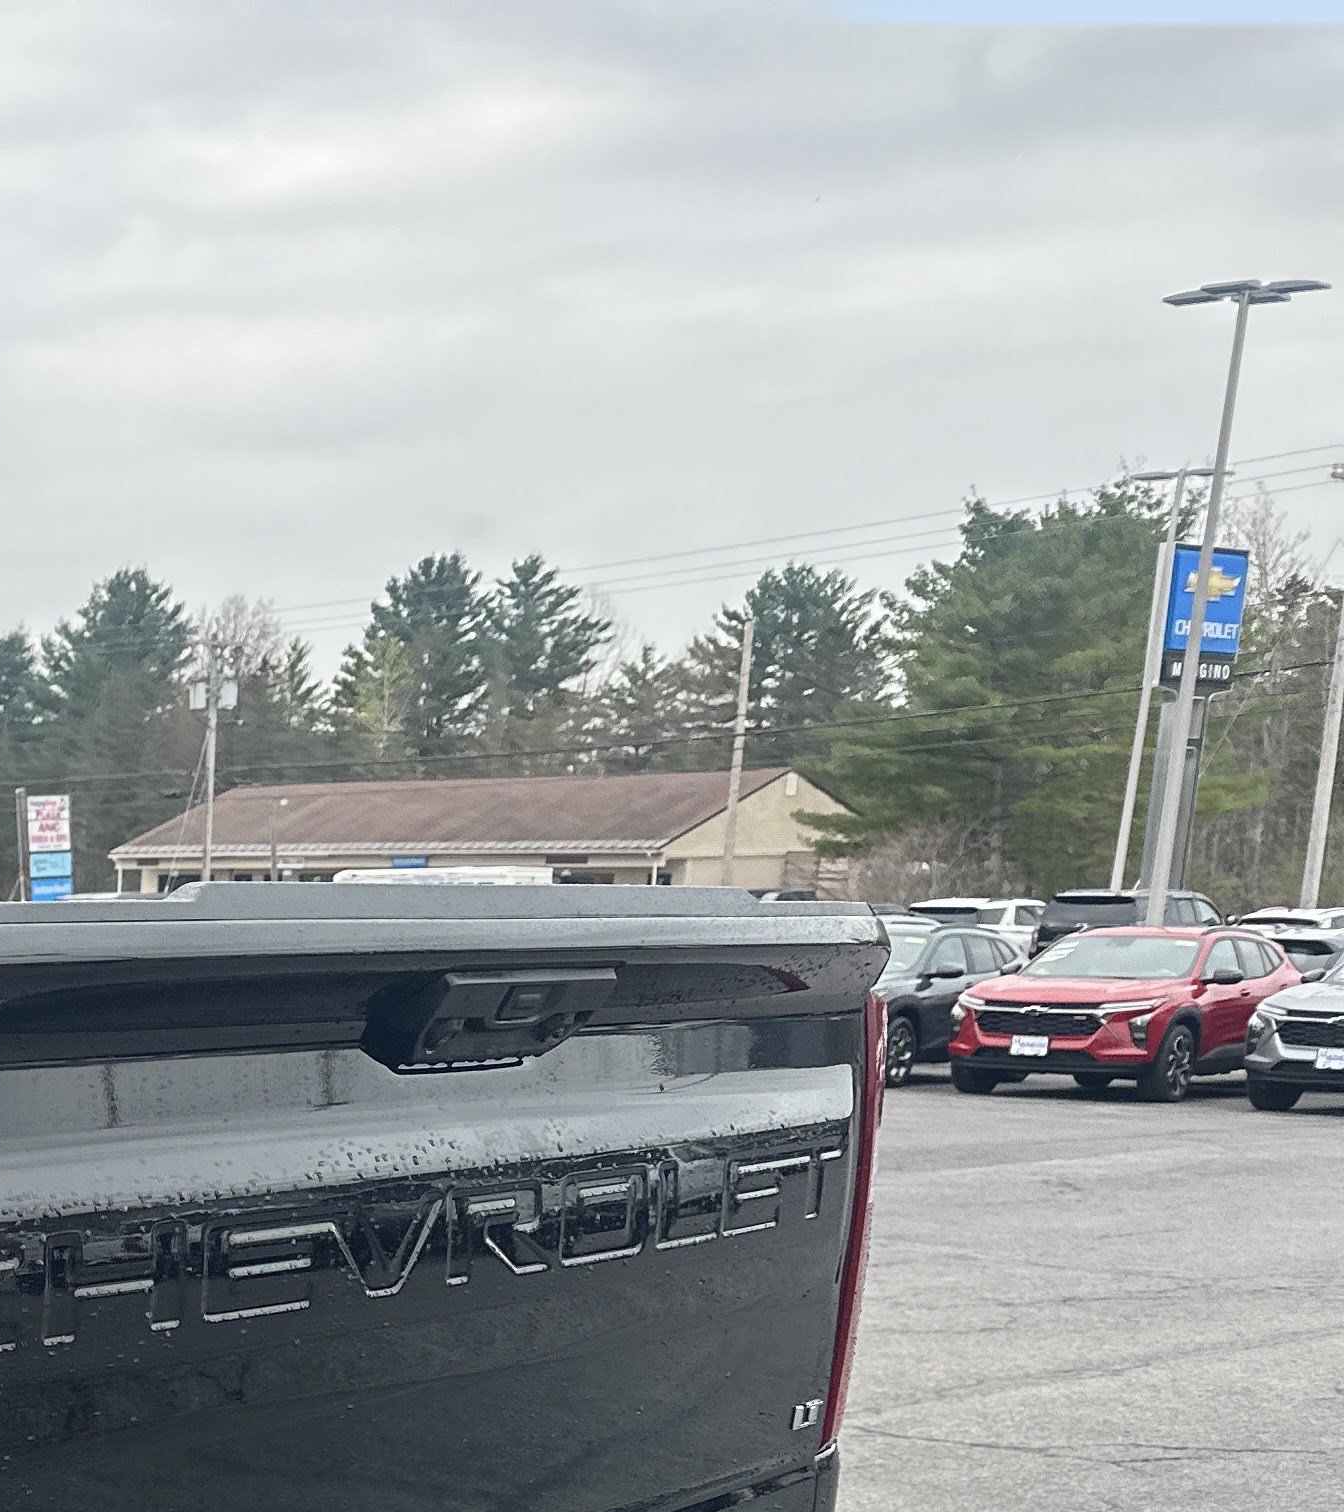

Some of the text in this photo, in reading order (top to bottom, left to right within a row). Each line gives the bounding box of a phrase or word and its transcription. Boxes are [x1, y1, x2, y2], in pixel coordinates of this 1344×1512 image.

[1175, 619, 1239, 639] CHROLET
[1172, 661, 1231, 680] MGINO
[792, 1399, 824, 1431] LT
